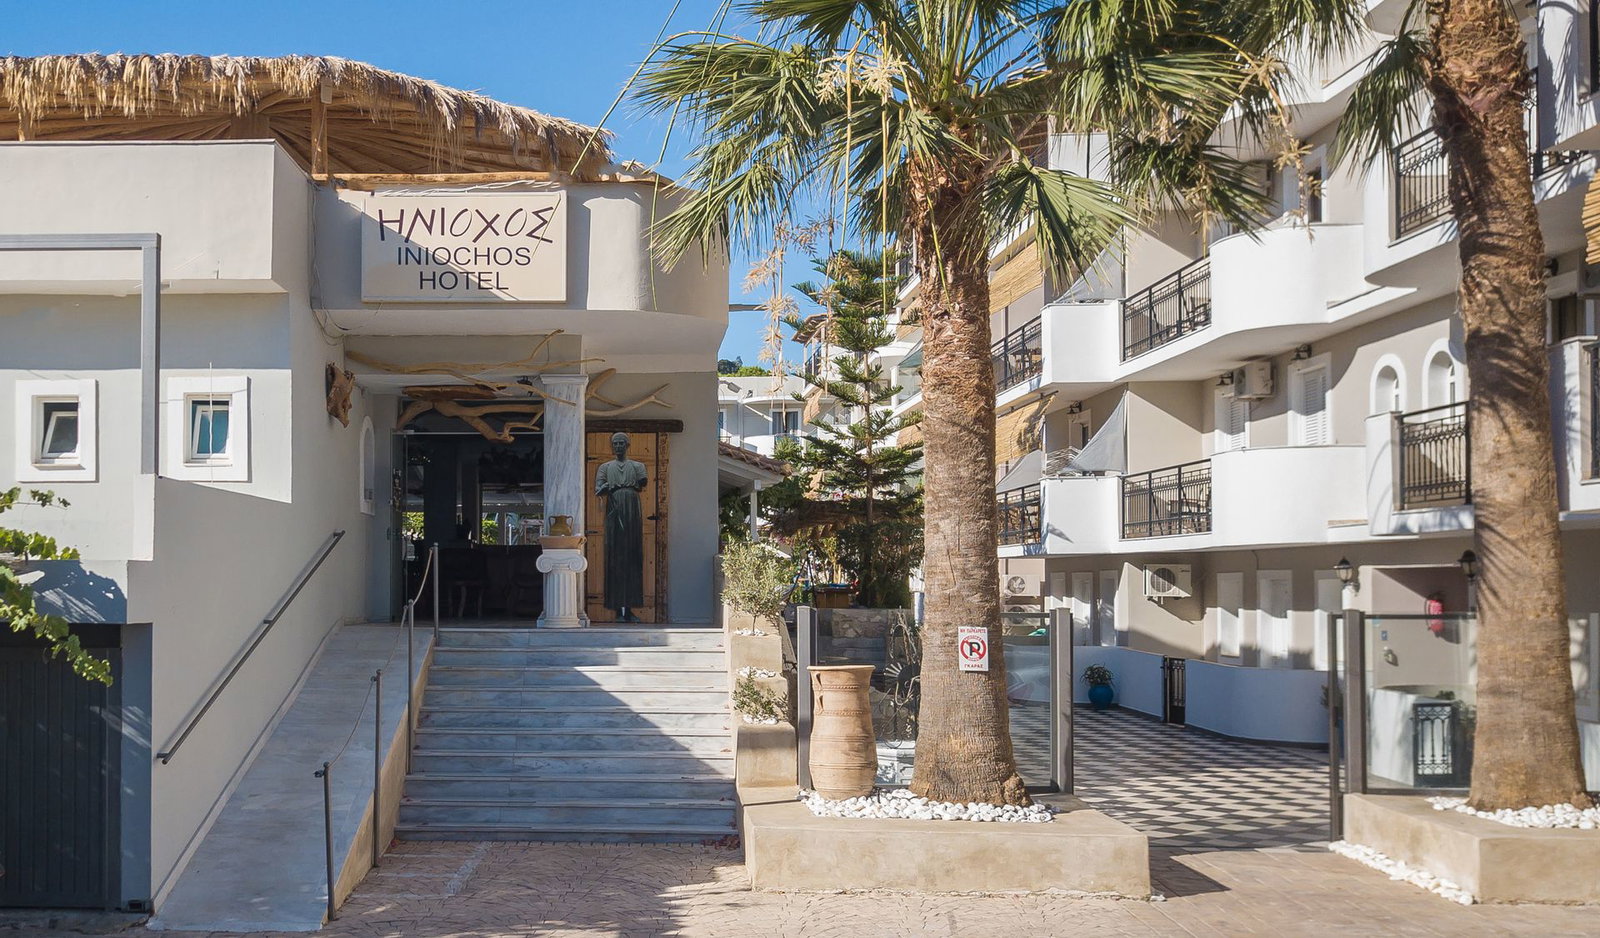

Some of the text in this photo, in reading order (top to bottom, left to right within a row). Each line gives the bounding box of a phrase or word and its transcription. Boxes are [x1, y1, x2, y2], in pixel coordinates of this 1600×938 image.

[378, 206, 554, 244] ΗΝΙΟΧΟΣ
[398, 246, 531, 266] INIOCHOS
[419, 271, 509, 290] HOTEL
[969, 641, 981, 656] P
